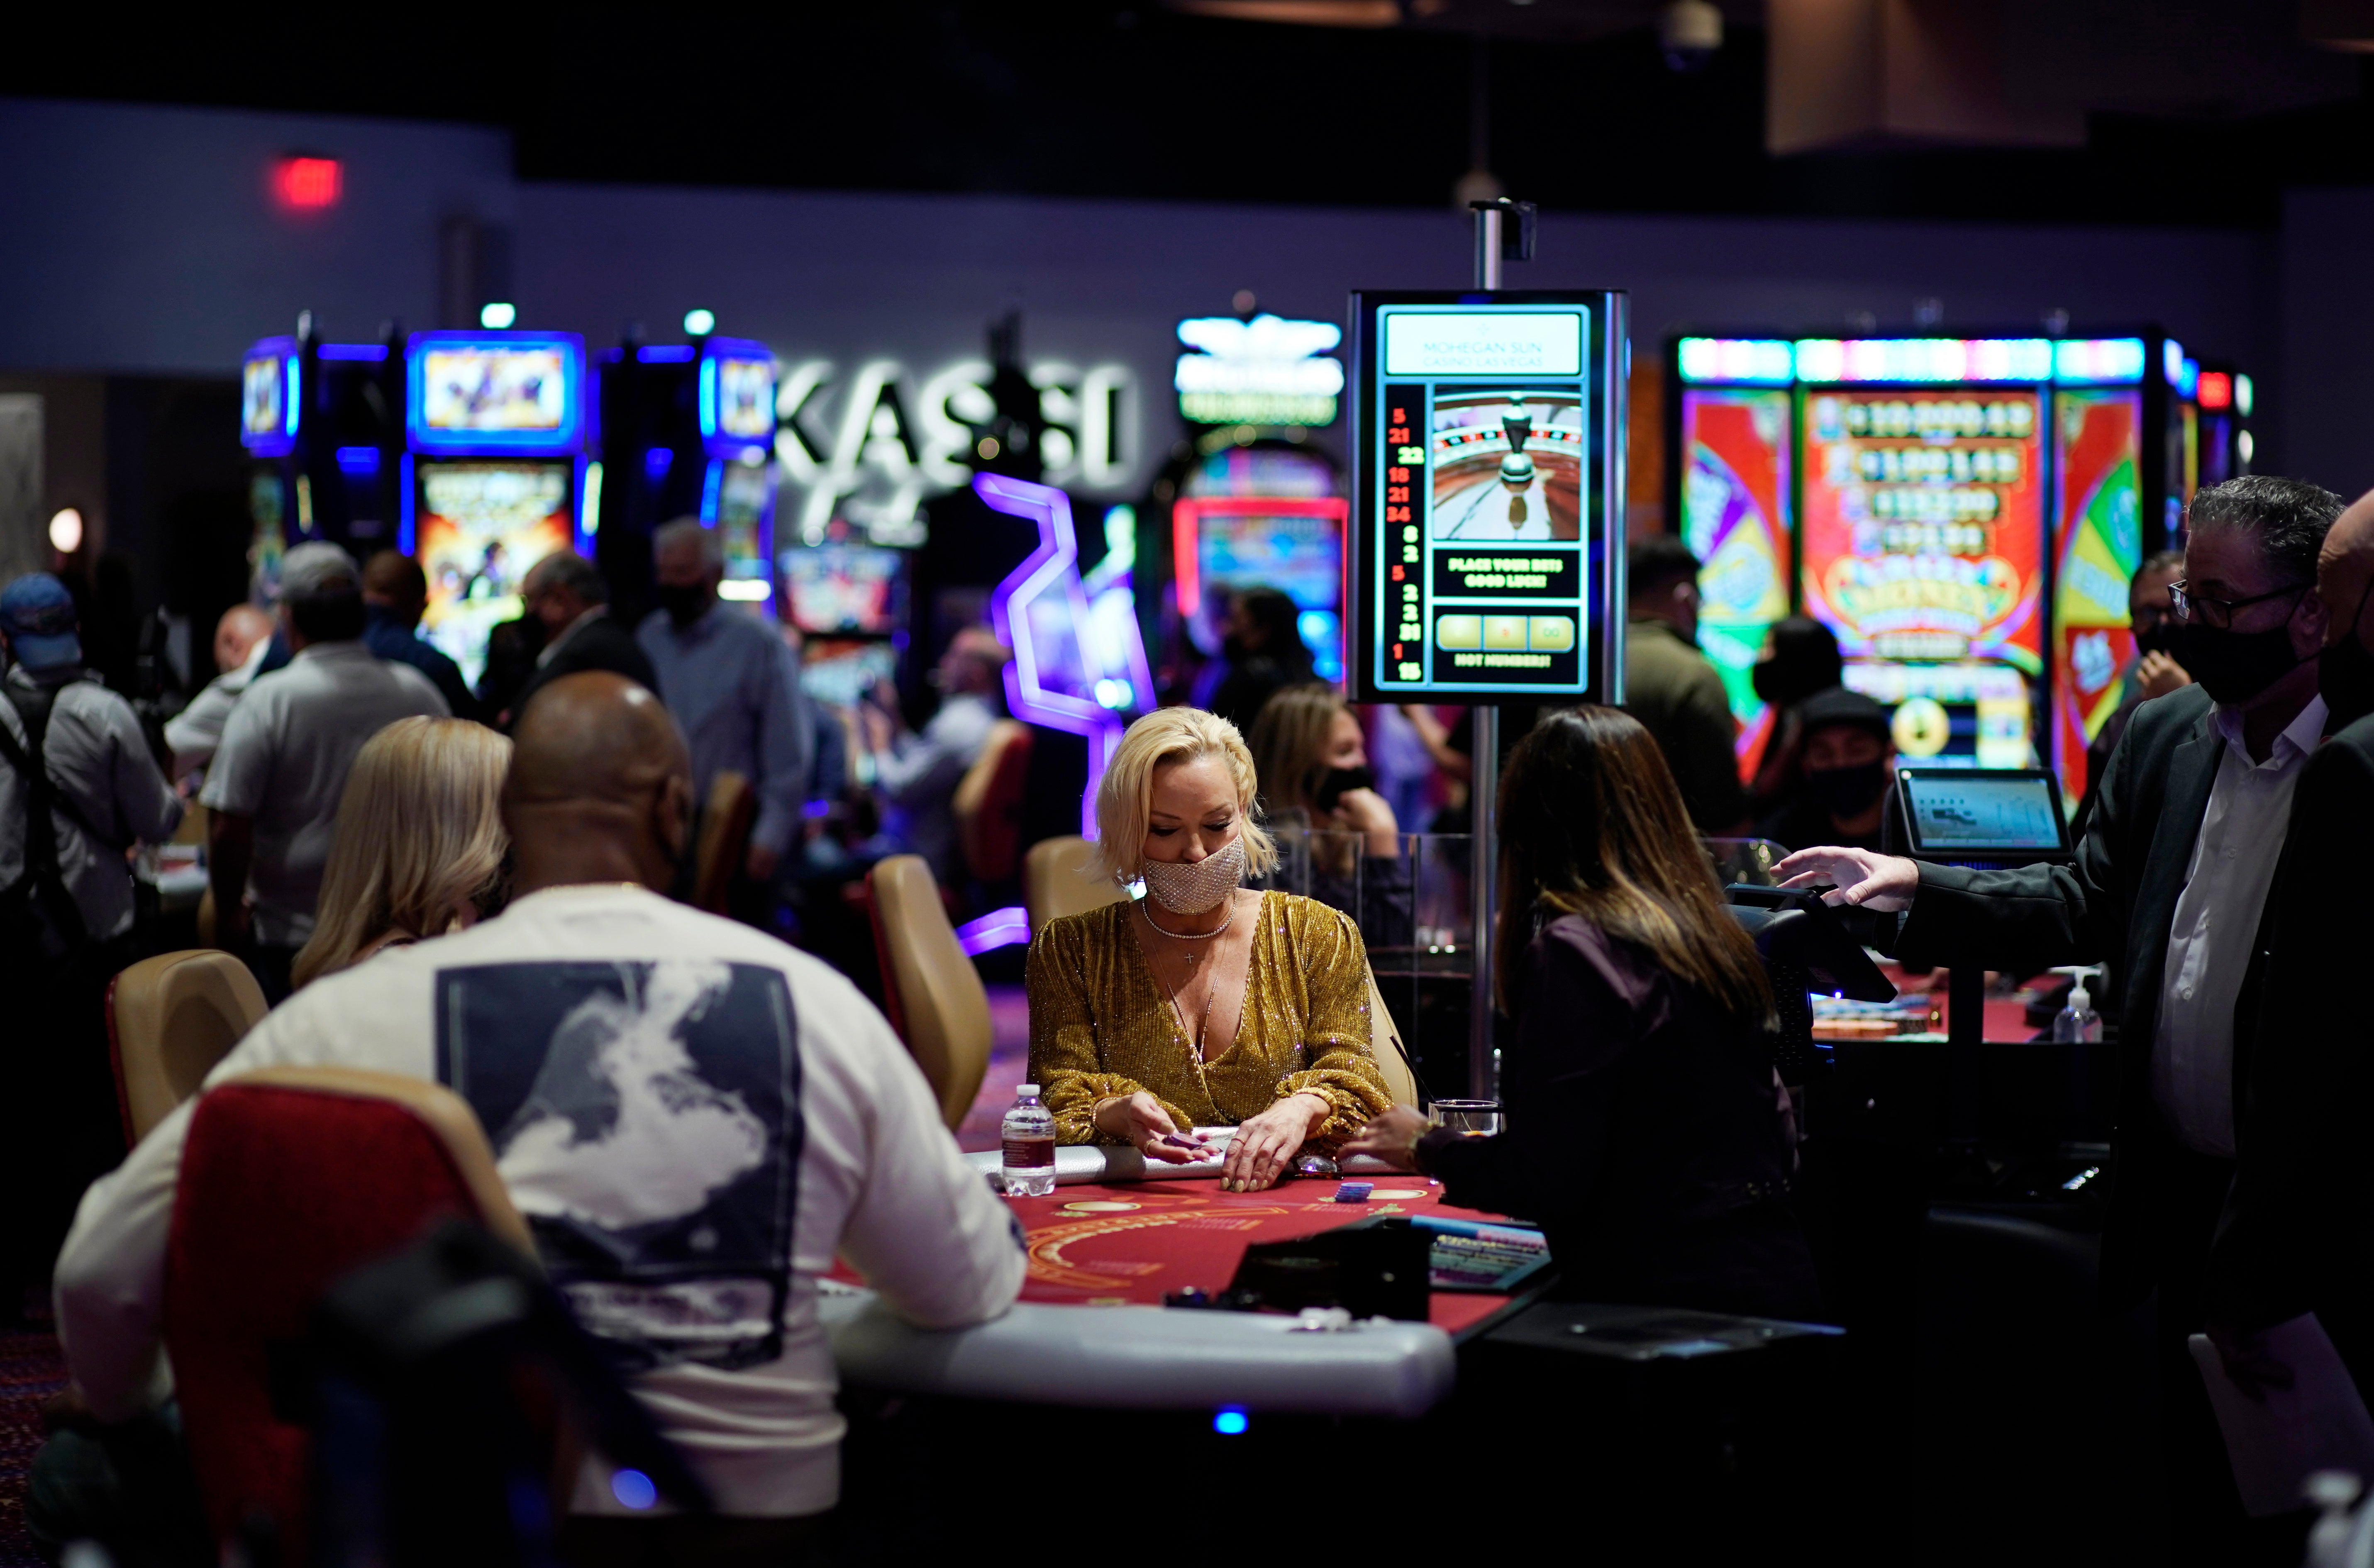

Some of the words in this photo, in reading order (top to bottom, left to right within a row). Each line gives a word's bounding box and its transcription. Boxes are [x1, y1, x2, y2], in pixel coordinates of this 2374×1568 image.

[1423, 341, 1506, 354] MOHEGAN
[1510, 341, 1542, 354] SUN
[1423, 356, 1471, 367] CASINO
[1476, 356, 1499, 367] LAS
[1501, 356, 1542, 367] VEGAS
[1393, 408, 1406, 424] 5
[1388, 427, 1410, 444] 21
[1398, 446, 1425, 465] 22
[1388, 467, 1410, 483] 18
[1388, 486, 1409, 502] 21
[1386, 506, 1410, 522] 34
[1403, 544, 1419, 563] 2
[1391, 565, 1405, 581] 5
[1448, 558, 1493, 572] PLACE
[1493, 558, 1530, 572] YOUR
[1464, 573, 1505, 588] GOOD
[1403, 584, 1419, 602] 2
[1403, 603, 1419, 622] 2
[1393, 644, 1403, 660] 1
[1454, 653, 1483, 667] HOT
[1398, 662, 1422, 680] 15
